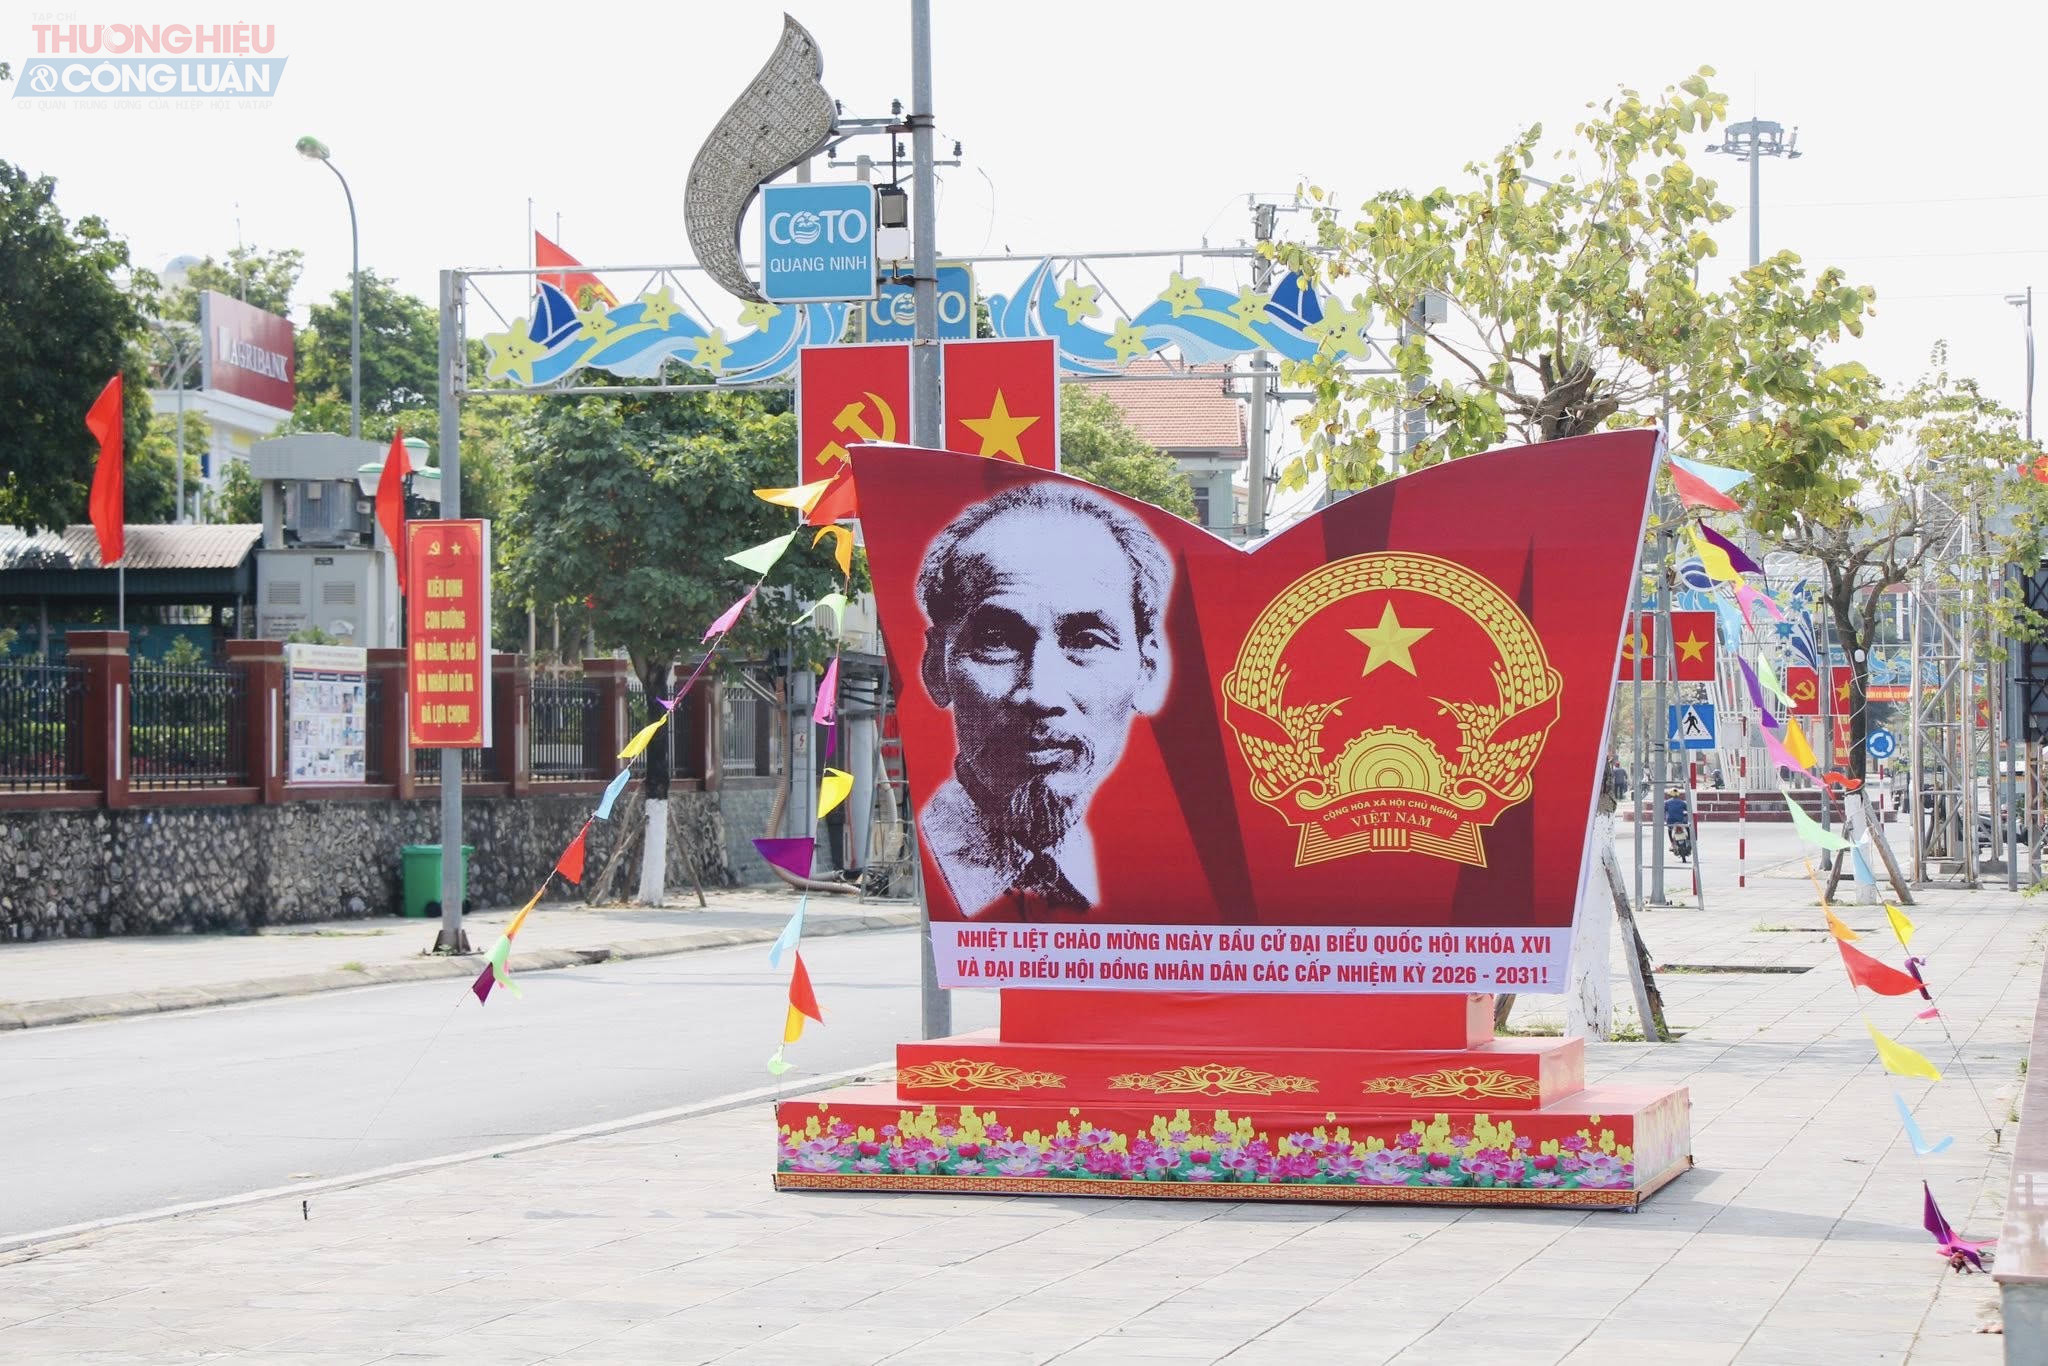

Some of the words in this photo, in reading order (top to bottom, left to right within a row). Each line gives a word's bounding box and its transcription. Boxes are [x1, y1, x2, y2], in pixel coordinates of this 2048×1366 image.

[770, 256, 824, 273] QUANG
[830, 255, 867, 271] NINH
[1323, 806, 1349, 821] CỘNG
[1350, 800, 1371, 811] HÒA
[1373, 798, 1387, 806] XÃ
[1389, 799, 1406, 807] HỘI
[1407, 799, 1428, 810] CHỦ
[1429, 805, 1458, 820] NGHĨA
[1351, 809, 1391, 827] VIỆT
[1395, 811, 1433, 828] NAM
[957, 927, 1008, 952] NHIỆT
[1013, 928, 1048, 952] LIỆT
[1053, 928, 1101, 950] CHÀO
[1106, 928, 1160, 951] MỪNG
[1165, 930, 1214, 951] NGÀY
[1219, 928, 1255, 952] BẦU
[1260, 928, 1287, 952] CỬ
[1290, 934, 1321, 956] ĐẠI
[1326, 927, 1368, 953] BIỂU
[1373, 929, 1423, 955] QUỐC
[1428, 931, 1459, 957] HỘI
[1465, 931, 1516, 954] KHÓA
[1521, 935, 1551, 954] XVI
[957, 956, 980, 977] VÀ
[984, 960, 1014, 981] ĐẠI
[1019, 954, 1059, 979] BIỂU
[1064, 958, 1094, 983] HỘI
[1100, 956, 1149, 980] ĐỒNG
[1154, 959, 1204, 981] NHÂN
[1210, 960, 1247, 982] DÂN
[1252, 960, 1289, 982] CÁC
[1295, 958, 1331, 982] CẤP
[1337, 961, 1397, 986] NHIỆM
[1402, 962, 1426, 983] KỲ
[1431, 966, 1477, 984] 2026
[1495, 966, 1547, 984] 2031!
